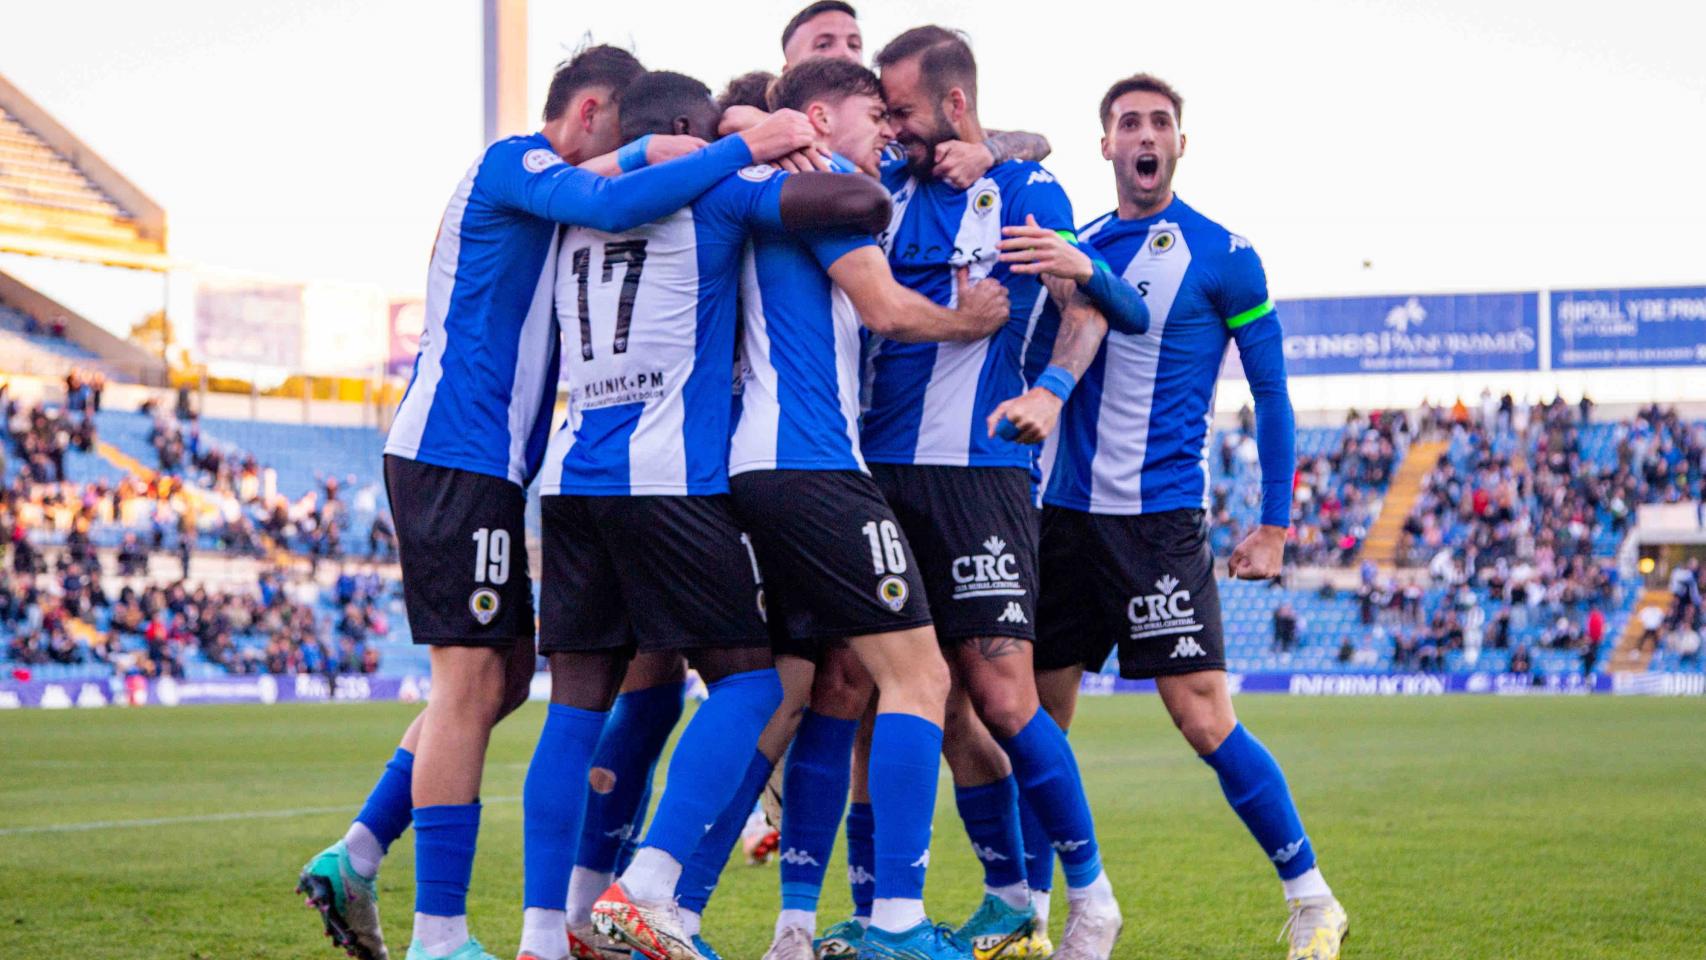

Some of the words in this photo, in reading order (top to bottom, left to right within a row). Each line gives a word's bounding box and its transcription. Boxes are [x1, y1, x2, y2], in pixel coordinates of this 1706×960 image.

[572, 239, 649, 362] 17
[472, 527, 511, 585] 19
[862, 519, 907, 575] 16
[952, 553, 1020, 584] CRC
[1127, 590, 1195, 625] CRC
